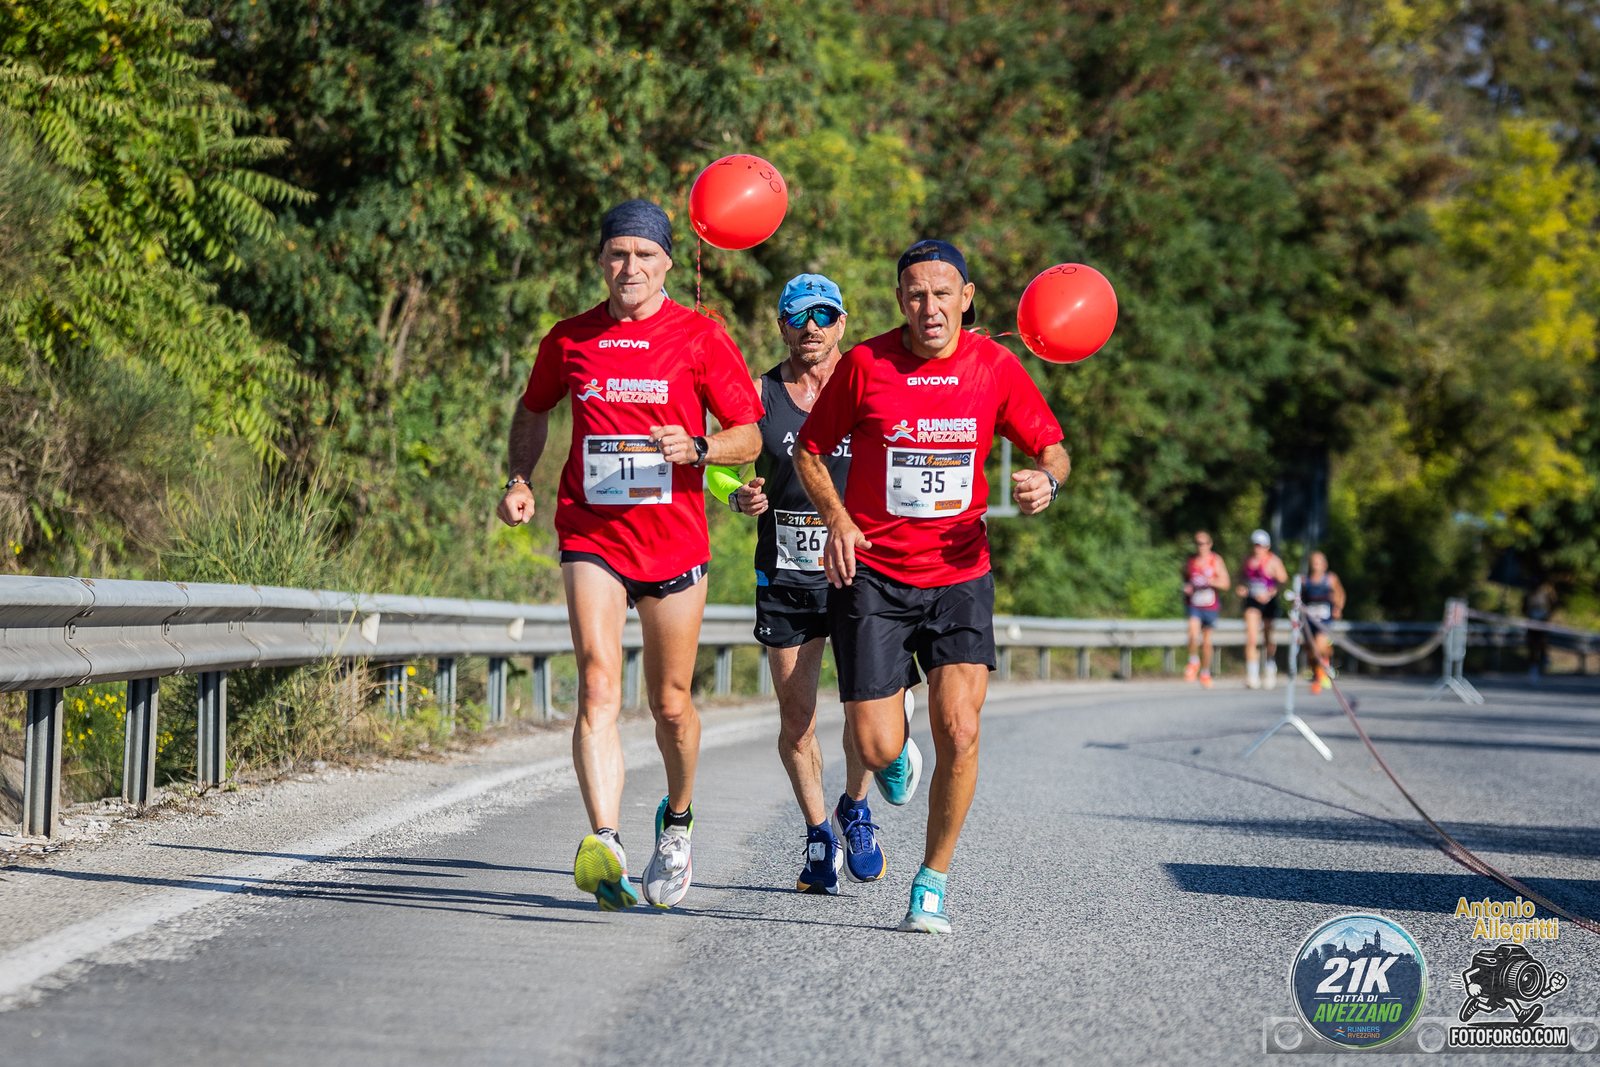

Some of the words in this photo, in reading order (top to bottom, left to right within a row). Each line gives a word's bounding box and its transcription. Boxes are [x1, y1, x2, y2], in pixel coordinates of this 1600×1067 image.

[598, 339, 650, 350] GIVOVA
[605, 378, 669, 393] RUNNERS
[906, 376, 959, 386] GIVOVA
[605, 391, 669, 405] AVEZZANO
[917, 418, 977, 432] RUNNERS
[917, 430, 977, 443] AVEZZANO
[600, 441, 619, 453] 21K
[905, 454, 928, 466] 21K
[618, 456, 635, 480] 11
[920, 470, 945, 493] 35
[787, 515, 806, 526] 21K
[795, 530, 828, 552] 26
